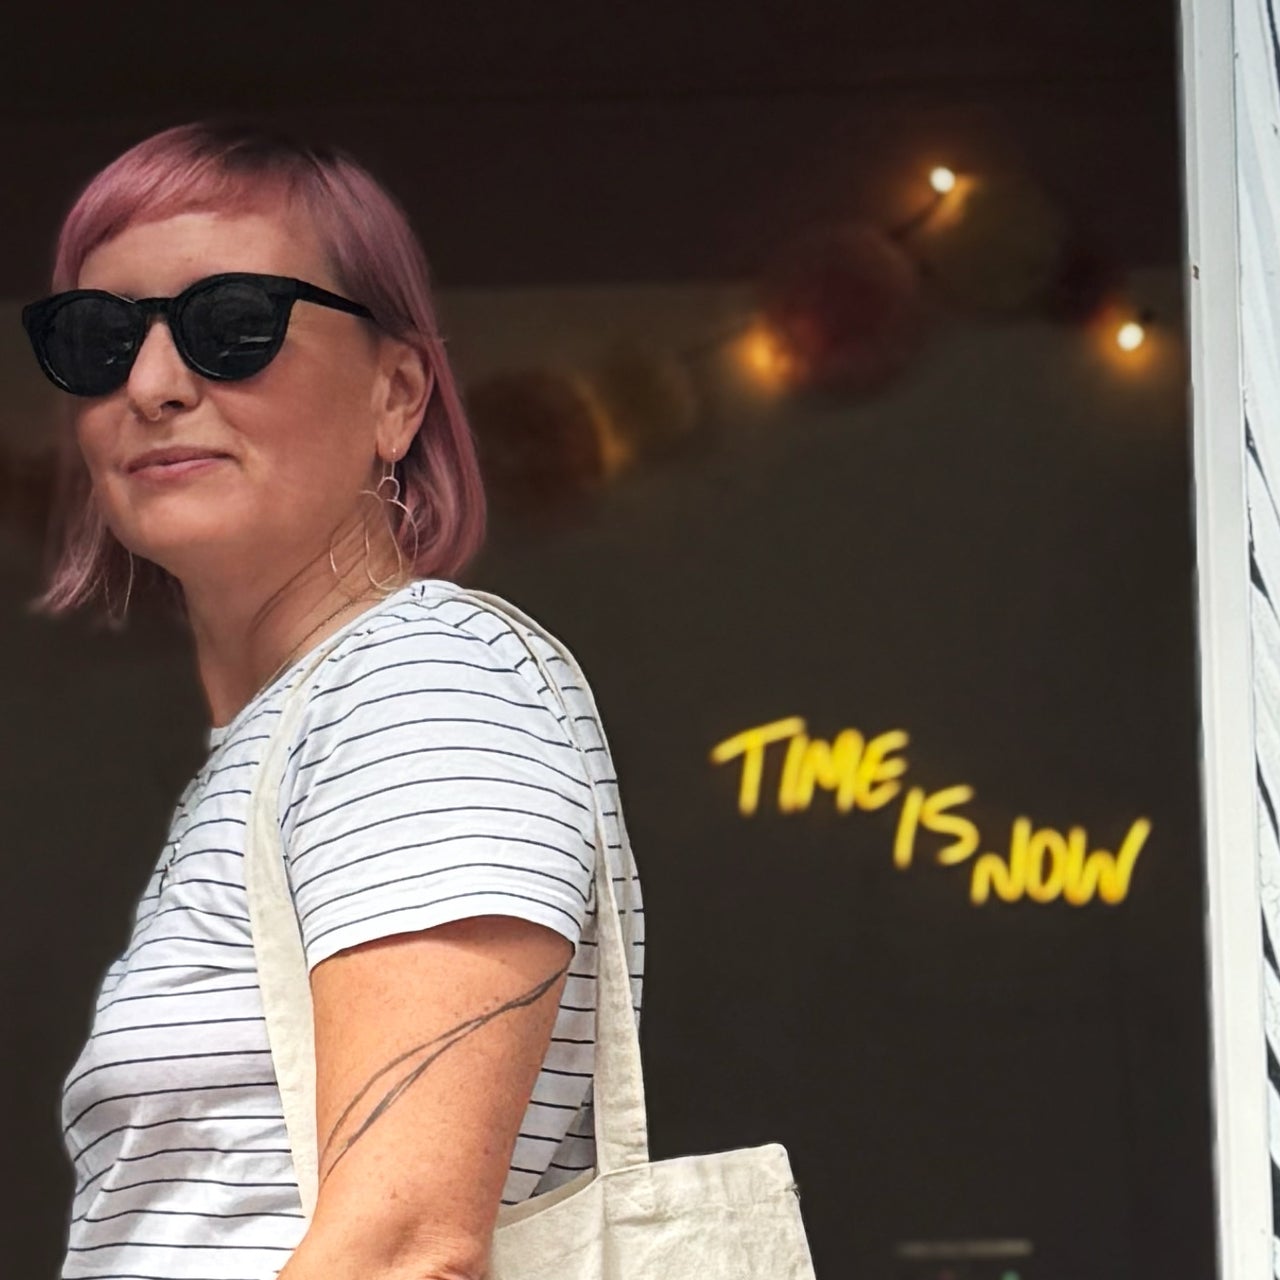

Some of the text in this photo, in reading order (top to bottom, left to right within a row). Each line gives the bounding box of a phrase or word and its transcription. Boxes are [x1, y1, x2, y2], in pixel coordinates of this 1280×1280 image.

[710, 715, 1151, 906] TIME IS NOW
